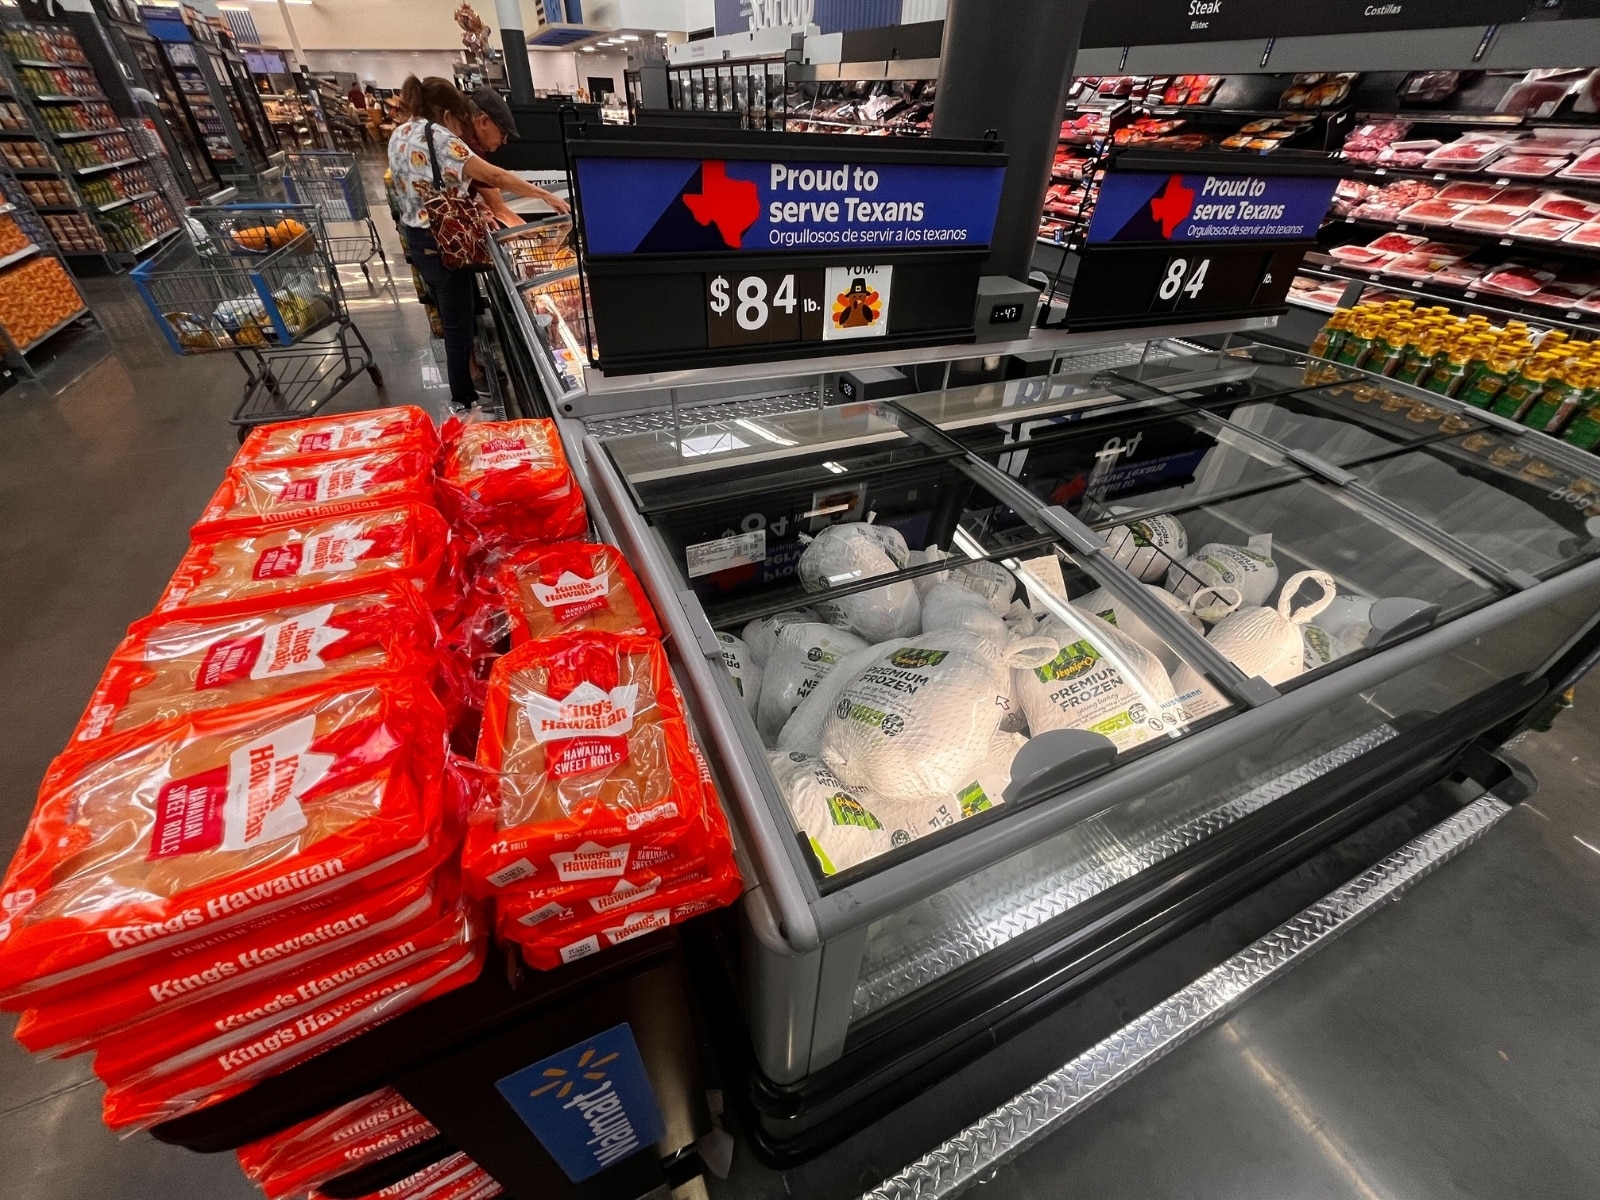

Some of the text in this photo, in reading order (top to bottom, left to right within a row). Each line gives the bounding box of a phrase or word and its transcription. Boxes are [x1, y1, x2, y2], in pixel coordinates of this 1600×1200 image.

[1188, 0, 1221, 16] Steak
[1364, 4, 1402, 16] Costillas
[1190, 20, 1209, 30] Bistec
[770, 163, 879, 192] Proud to
[1201, 176, 1266, 197] Proud to
[769, 197, 925, 223] serve Texans
[1193, 201, 1285, 220] serve Texans
[769, 227, 967, 247] Orgullosos de servir a los texanos
[1187, 224, 1229, 238] Orgullosos
[1228, 225, 1239, 236] de
[1239, 224, 1260, 236] servir
[1264, 224, 1275, 235] los
[1275, 224, 1304, 235] texanos
[1160, 258, 1210, 300] 84
[803, 298, 821, 313] lb.
[309, 501, 381, 517] Hawaiian
[545, 583, 605, 602] Hawaiian
[554, 582, 592, 594] King's
[267, 621, 298, 674] Hawaiian
[292, 627, 315, 664] King's
[859, 674, 919, 696] FROZEN
[866, 666, 930, 687] PREMIUM
[1059, 675, 1125, 712] FROZEN
[1077, 701, 1099, 717] young
[1097, 692, 1119, 706] turkey
[541, 707, 628, 731] Hawaiian
[560, 699, 613, 718] King's
[554, 752, 621, 775] SWEET ROLLS
[563, 745, 612, 760] HAWAIIAN
[244, 744, 275, 843] Hawaiian
[159, 784, 189, 855] SWEET ROLLS
[184, 786, 208, 840] HAWAIIAN
[491, 840, 528, 855] 12 ROLLS
[562, 858, 622, 872] Hawaiian
[107, 858, 346, 948] King's Hawaiian
[171, 928, 248, 957] HAWAIIAN
[149, 912, 369, 1002] King's Hawaiian
[215, 941, 417, 1032] King's Hawaiian
[218, 1028, 296, 1071] King's
[563, 1080, 639, 1167] Walmart
